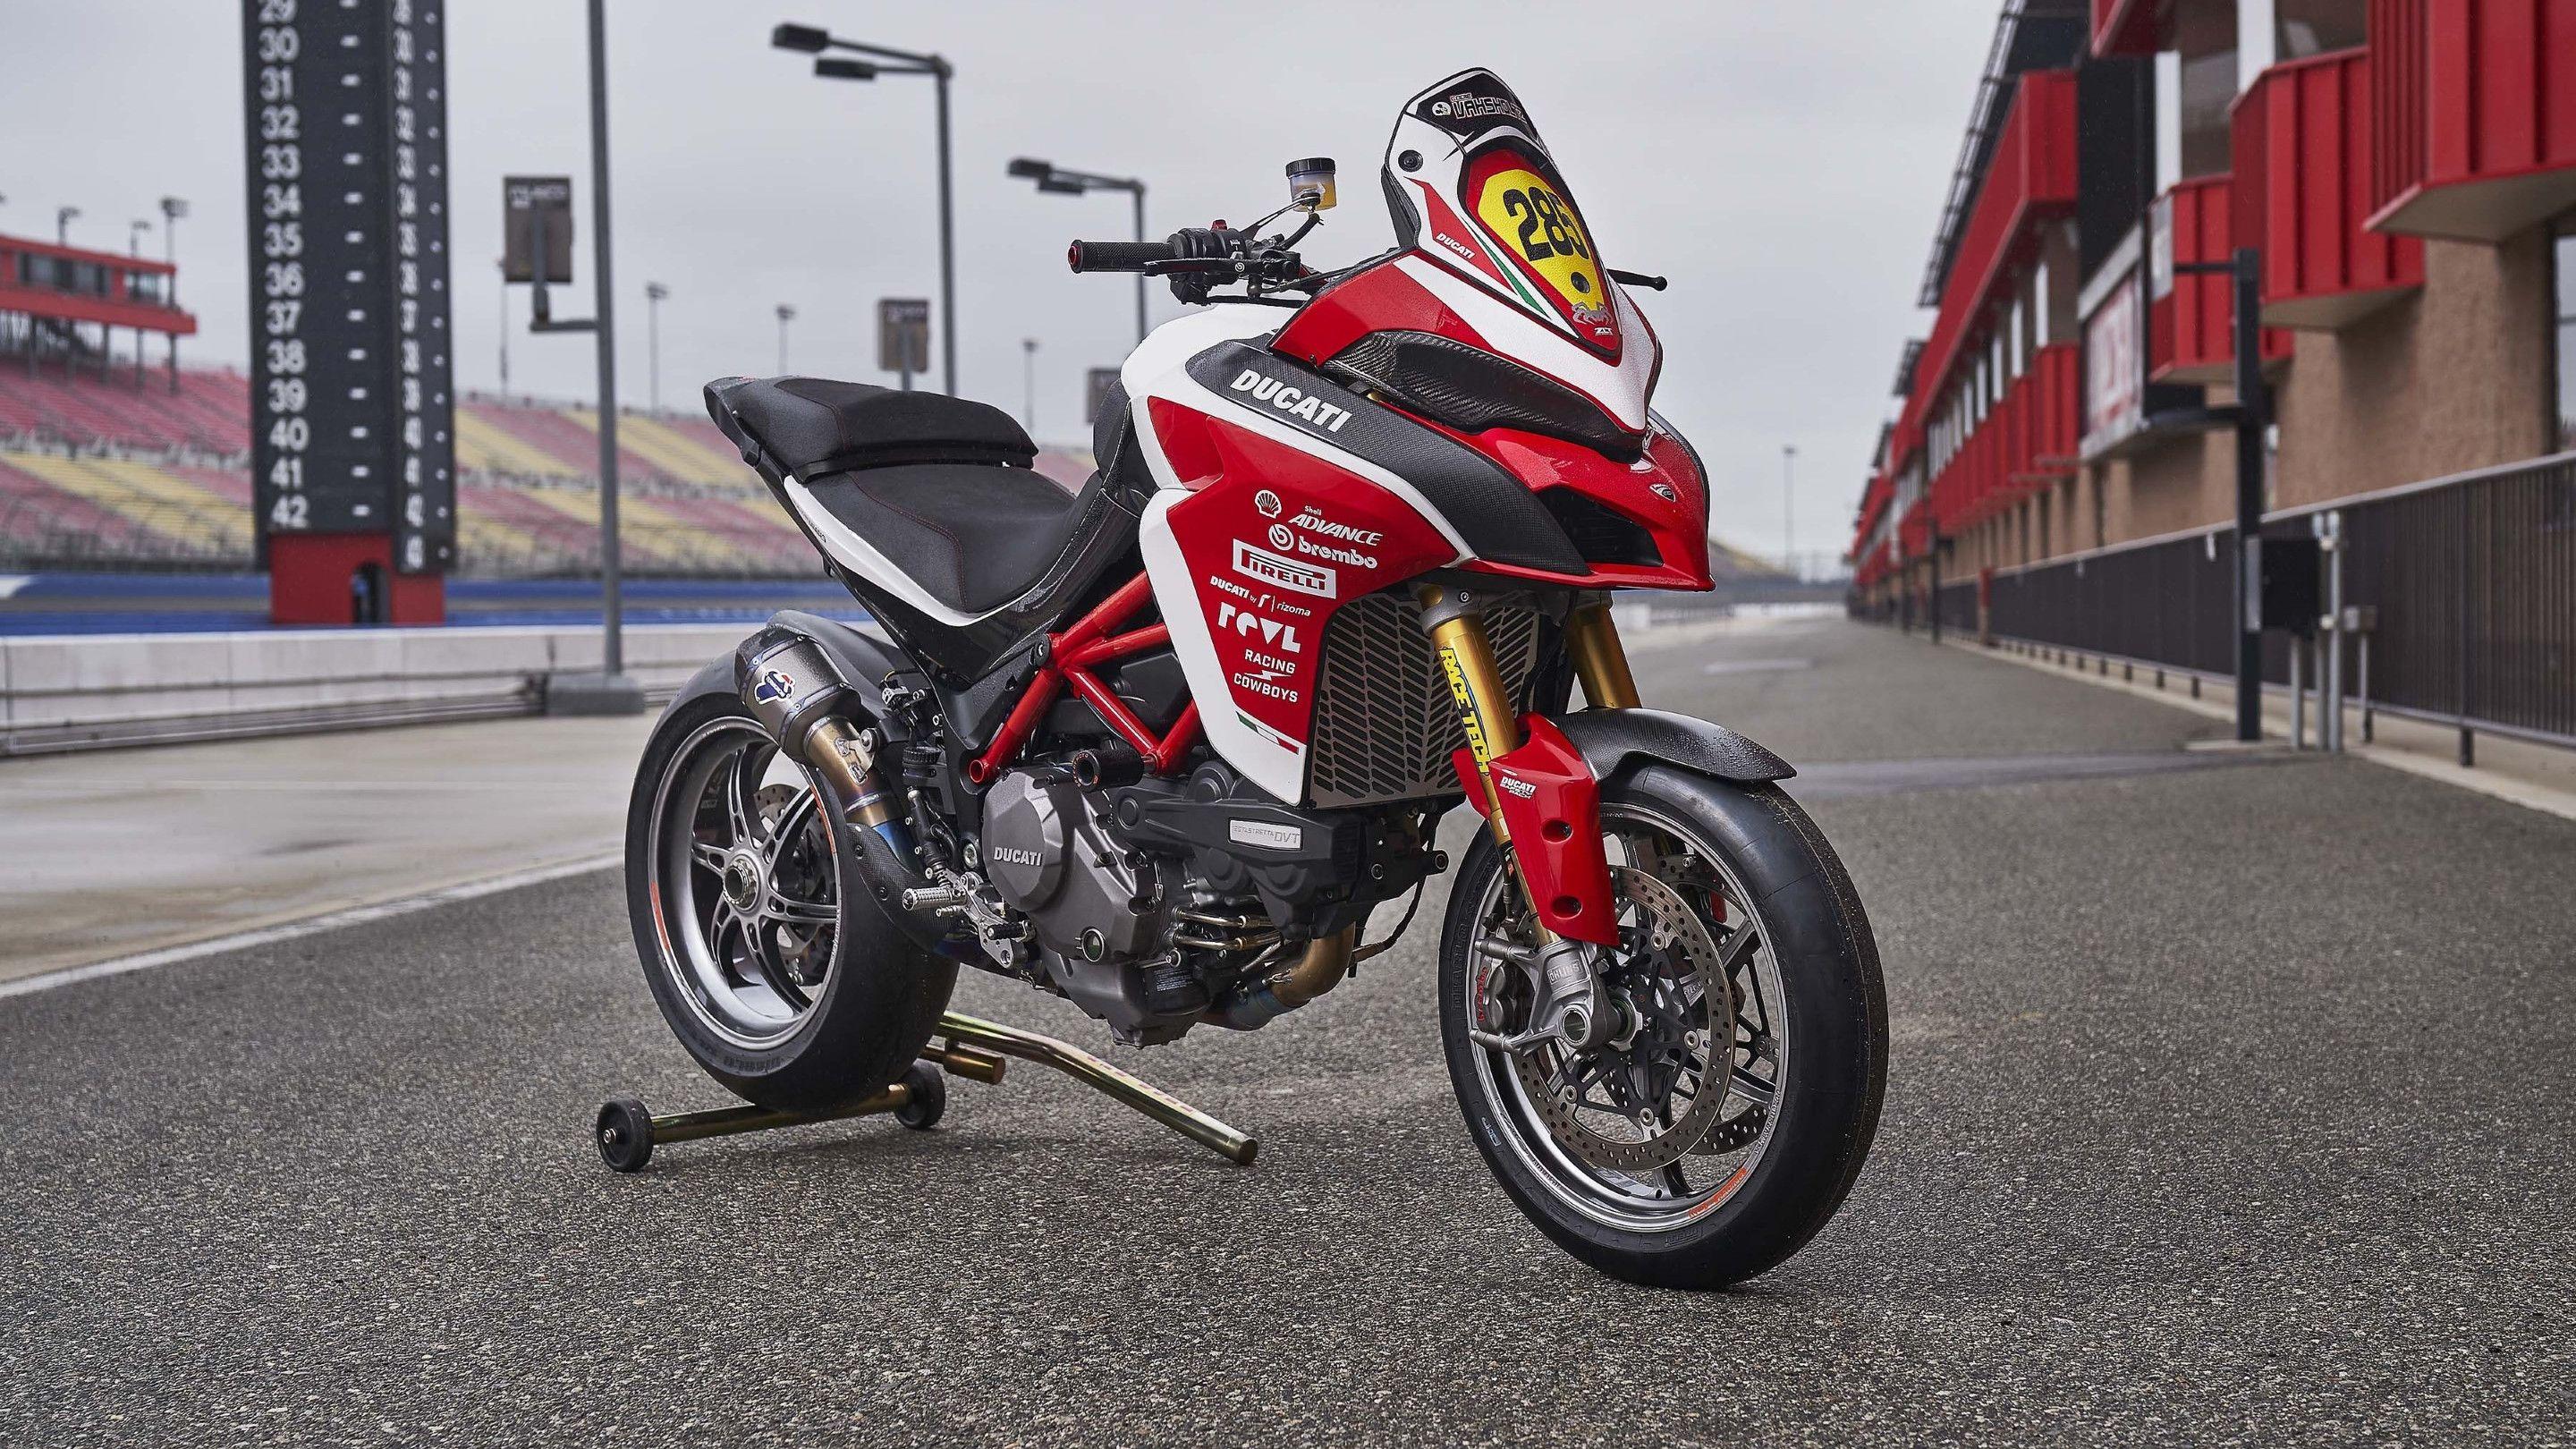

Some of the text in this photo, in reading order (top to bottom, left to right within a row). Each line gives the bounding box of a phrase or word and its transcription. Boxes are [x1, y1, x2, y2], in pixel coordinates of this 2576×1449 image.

[258, 26, 300, 62] 30
[259, 65, 294, 101] 31
[260, 105, 301, 140] 32
[262, 143, 301, 179] 33
[263, 183, 302, 218] 34
[264, 221, 303, 257] 35
[1503, 187, 1589, 260] 285
[1436, 232, 1476, 260] DUCATI
[266, 260, 305, 296] 36
[266, 300, 301, 334] 37
[267, 338, 306, 374] 38
[267, 377, 307, 413] 39
[1230, 369, 1352, 433] DUCATI
[269, 417, 309, 451] 40
[269, 456, 302, 489] 41
[270, 494, 309, 529] 42
[1304, 505, 1322, 516] Shell
[1288, 513, 1384, 547] ADVANCE
[1241, 546, 1326, 591] PIRELLI
[1298, 536, 1377, 569] brembo
[1210, 575, 1250, 599] DUCATI
[1277, 601, 1311, 617] rizoma
[1245, 649, 1295, 674] RACING
[1233, 673, 1299, 703] COWBOYS
[1439, 648, 1491, 775] RACE TECH
[1500, 775, 1537, 793] DUCATI
[1274, 831, 1301, 844] DVT
[993, 846, 1043, 867] DUCATI
